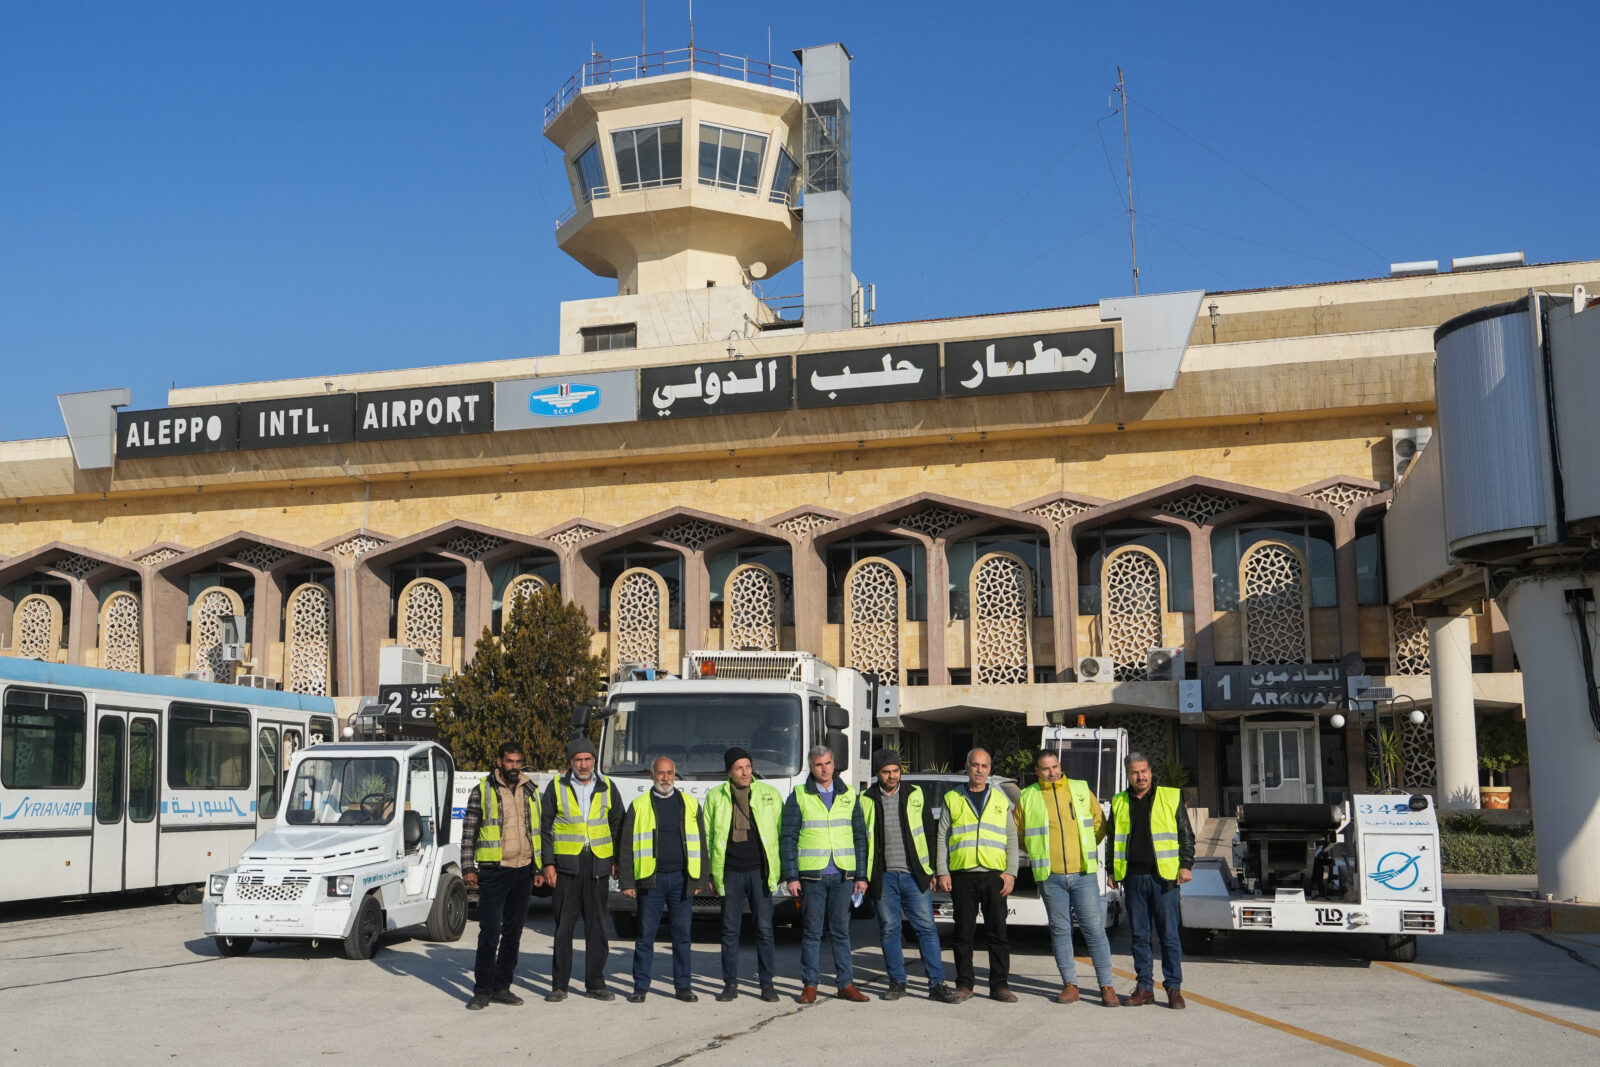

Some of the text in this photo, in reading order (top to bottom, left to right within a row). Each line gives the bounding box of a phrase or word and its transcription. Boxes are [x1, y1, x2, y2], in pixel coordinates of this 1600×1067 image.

[652, 340, 1097, 416] مطار حلب الدولي
[126, 395, 479, 447] ALEPPO INTL. AIRPORT
[1217, 675, 1231, 700] 1
[388, 692, 402, 714] 2
[3, 797, 82, 819] SYRIANAIR
[172, 797, 247, 818] السورية
[1315, 908, 1343, 925] TLD
